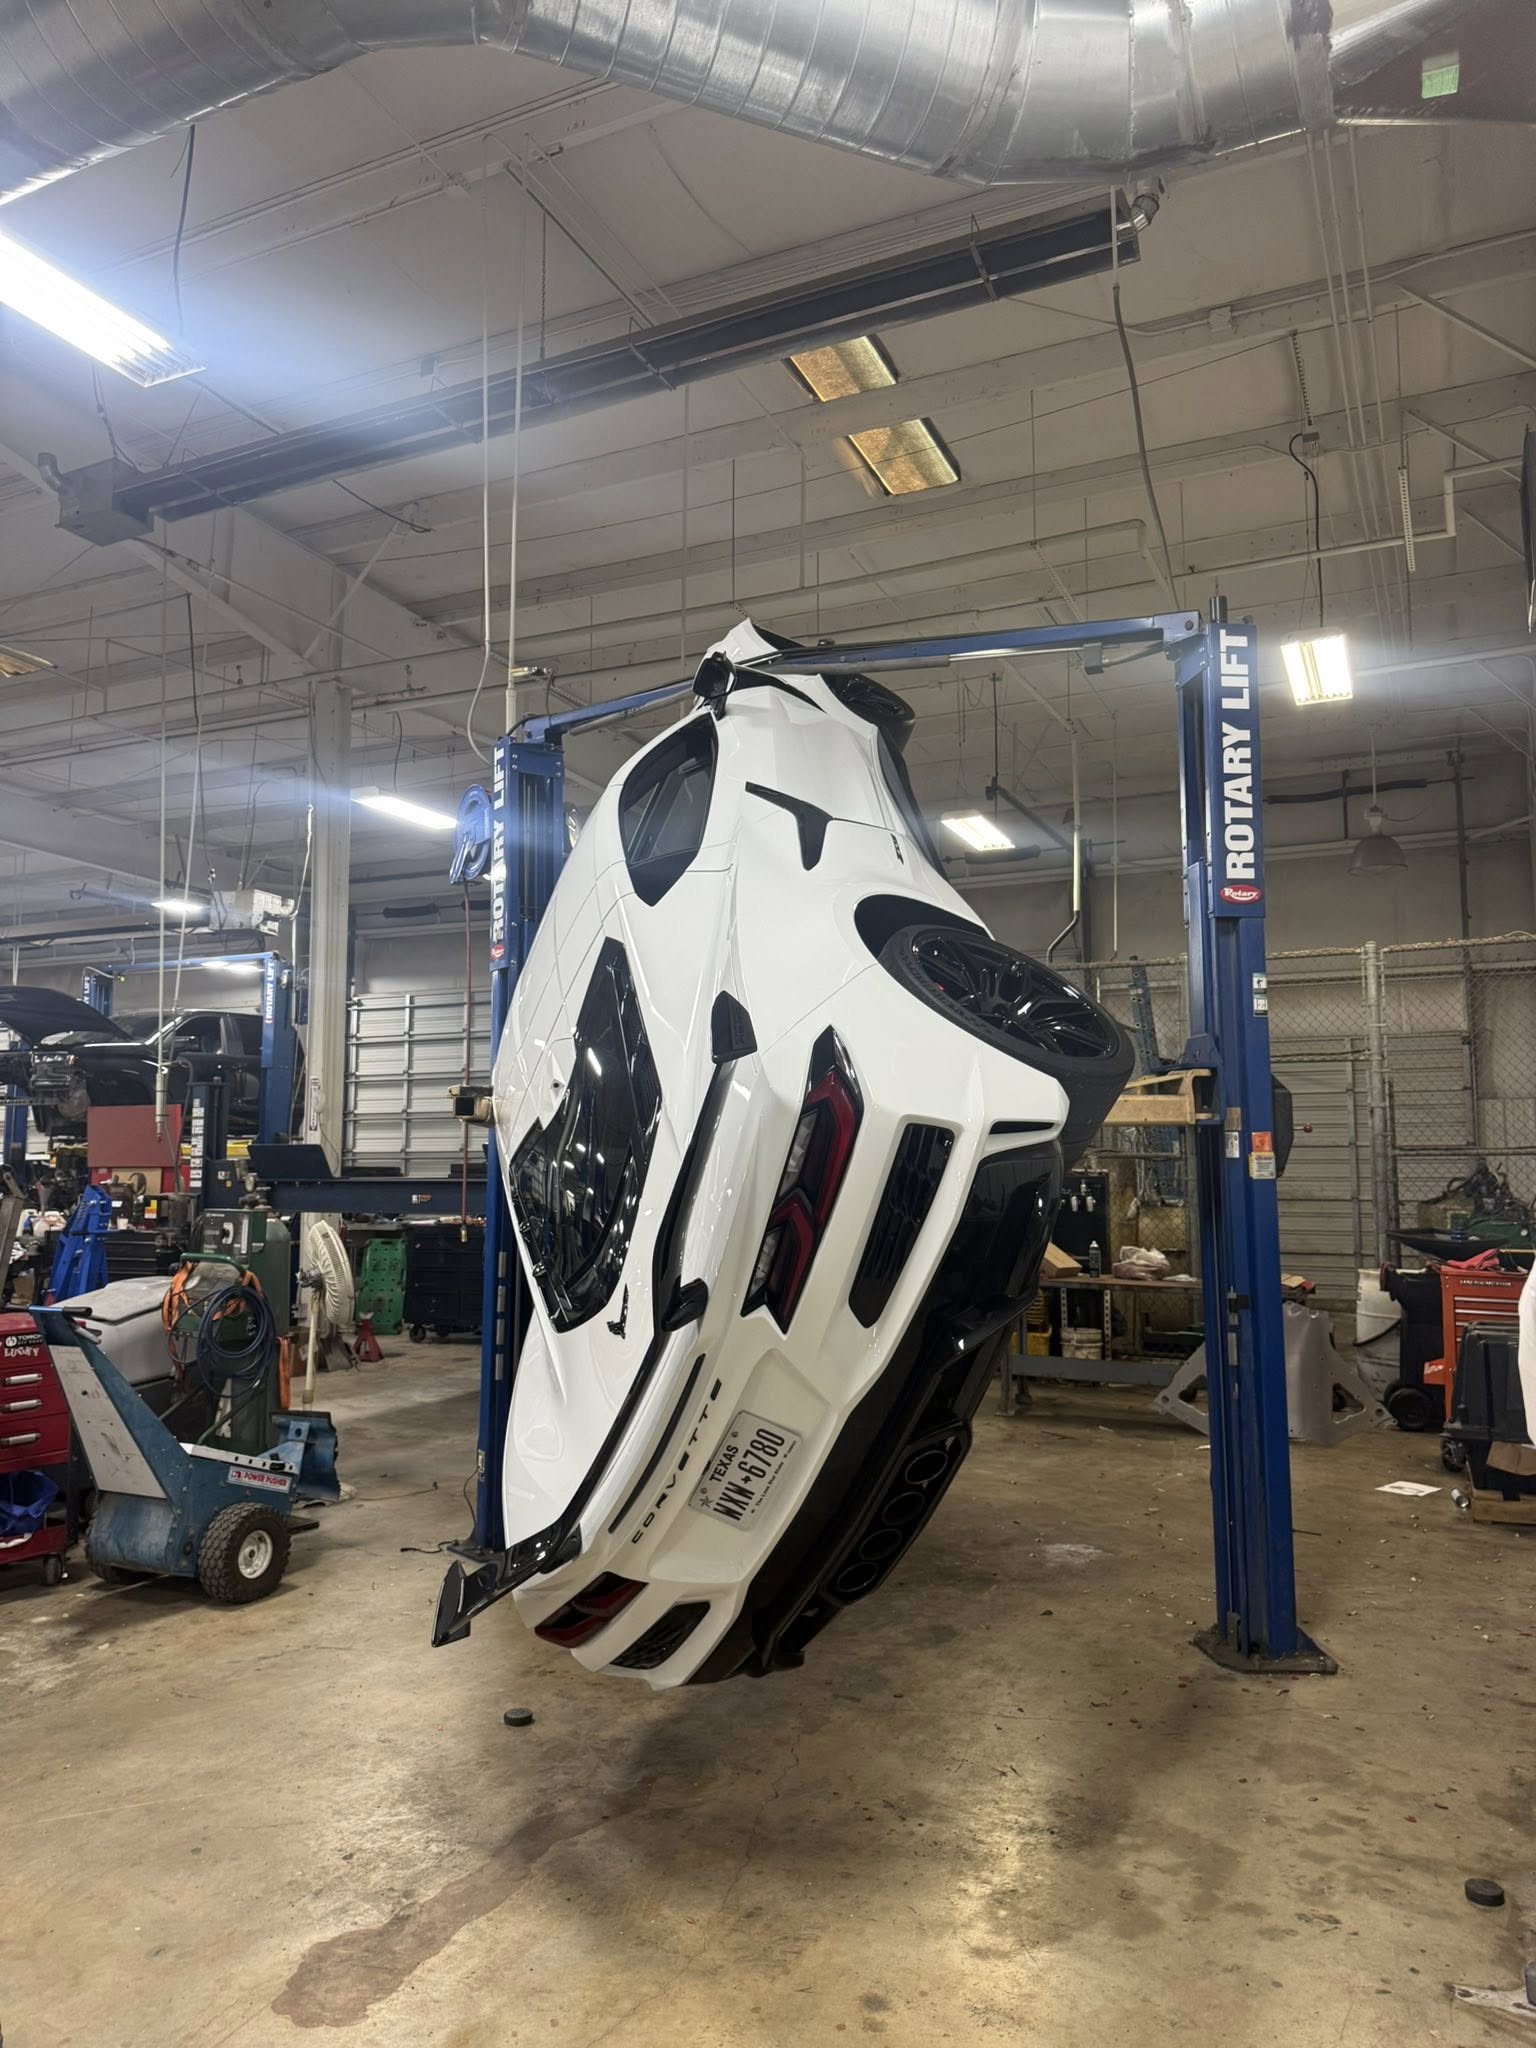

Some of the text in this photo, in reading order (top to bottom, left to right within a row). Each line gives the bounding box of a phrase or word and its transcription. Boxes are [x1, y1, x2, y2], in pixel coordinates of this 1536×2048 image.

[493, 746, 505, 811] LIFT
[1219, 628, 1256, 880] ROTARY LIFT
[1223, 887, 1258, 901] Rotary
[631, 1377, 723, 1545] CORVETTE
[709, 1444, 740, 1483] TEXAS
[737, 1428, 785, 1479] 6780
